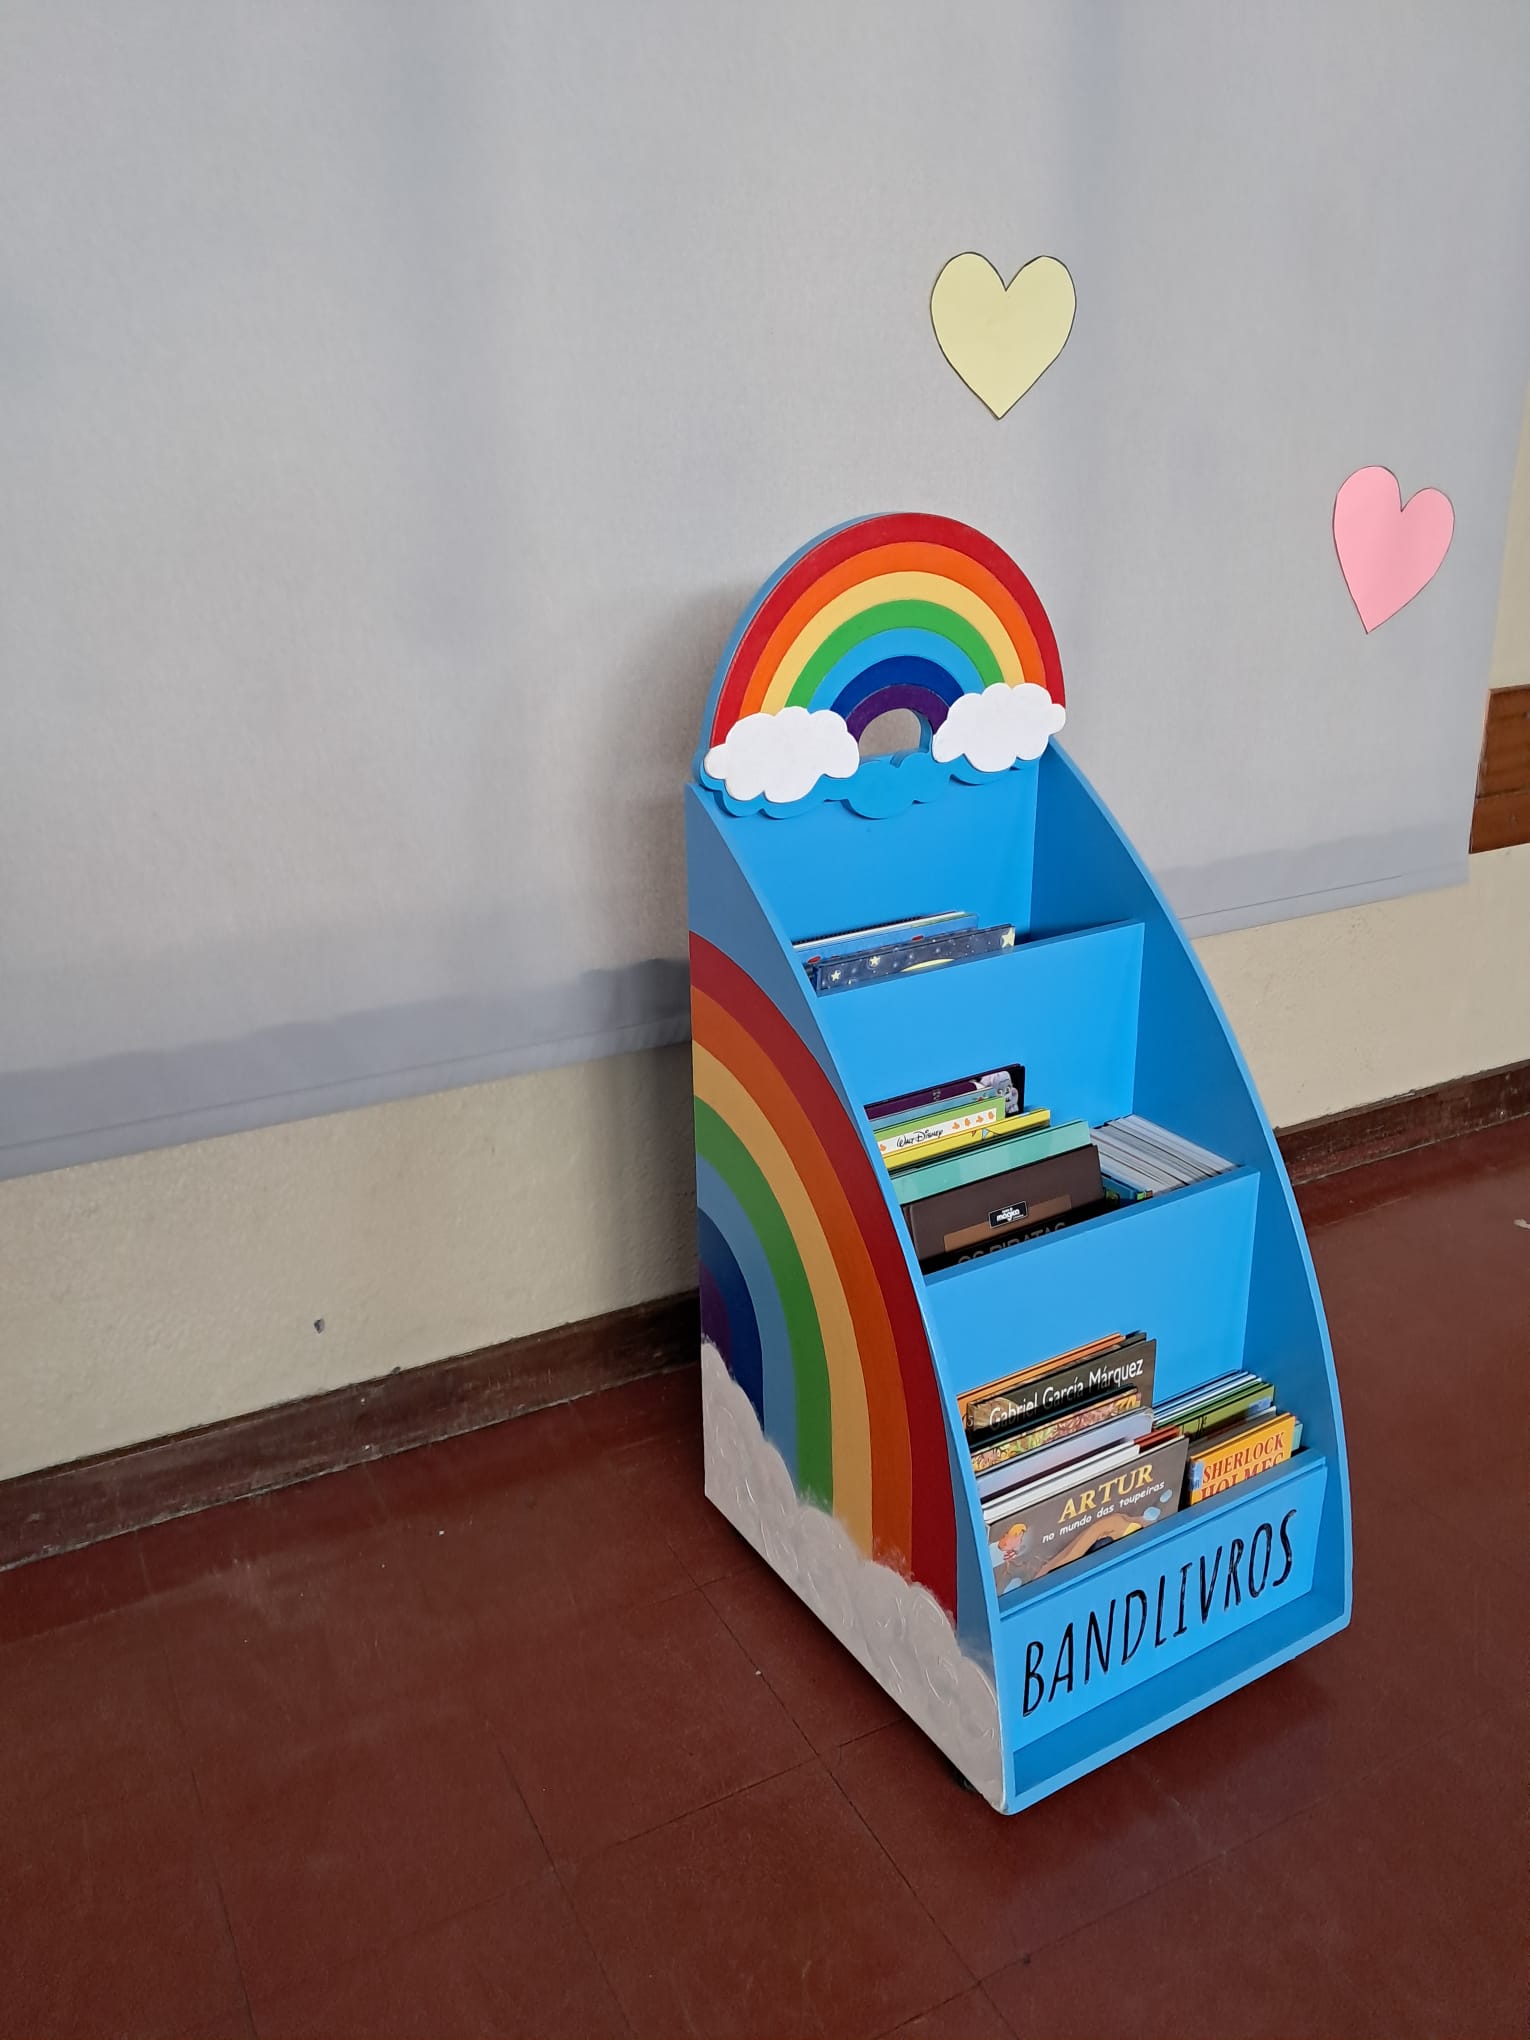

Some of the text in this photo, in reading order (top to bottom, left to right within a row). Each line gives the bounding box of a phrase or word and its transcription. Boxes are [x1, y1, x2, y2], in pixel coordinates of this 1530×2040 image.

[896, 1129, 944, 1148] Walt Disney
[989, 1358, 1144, 1431] Gabriel García Márquez
[1202, 1432, 1284, 1484] SHERLOCK
[1042, 1480, 1165, 1544] no mundo das toupeiras
[1058, 1464, 1153, 1524] ARTUR
[1022, 1508, 1297, 1718] BANDLIVROS
